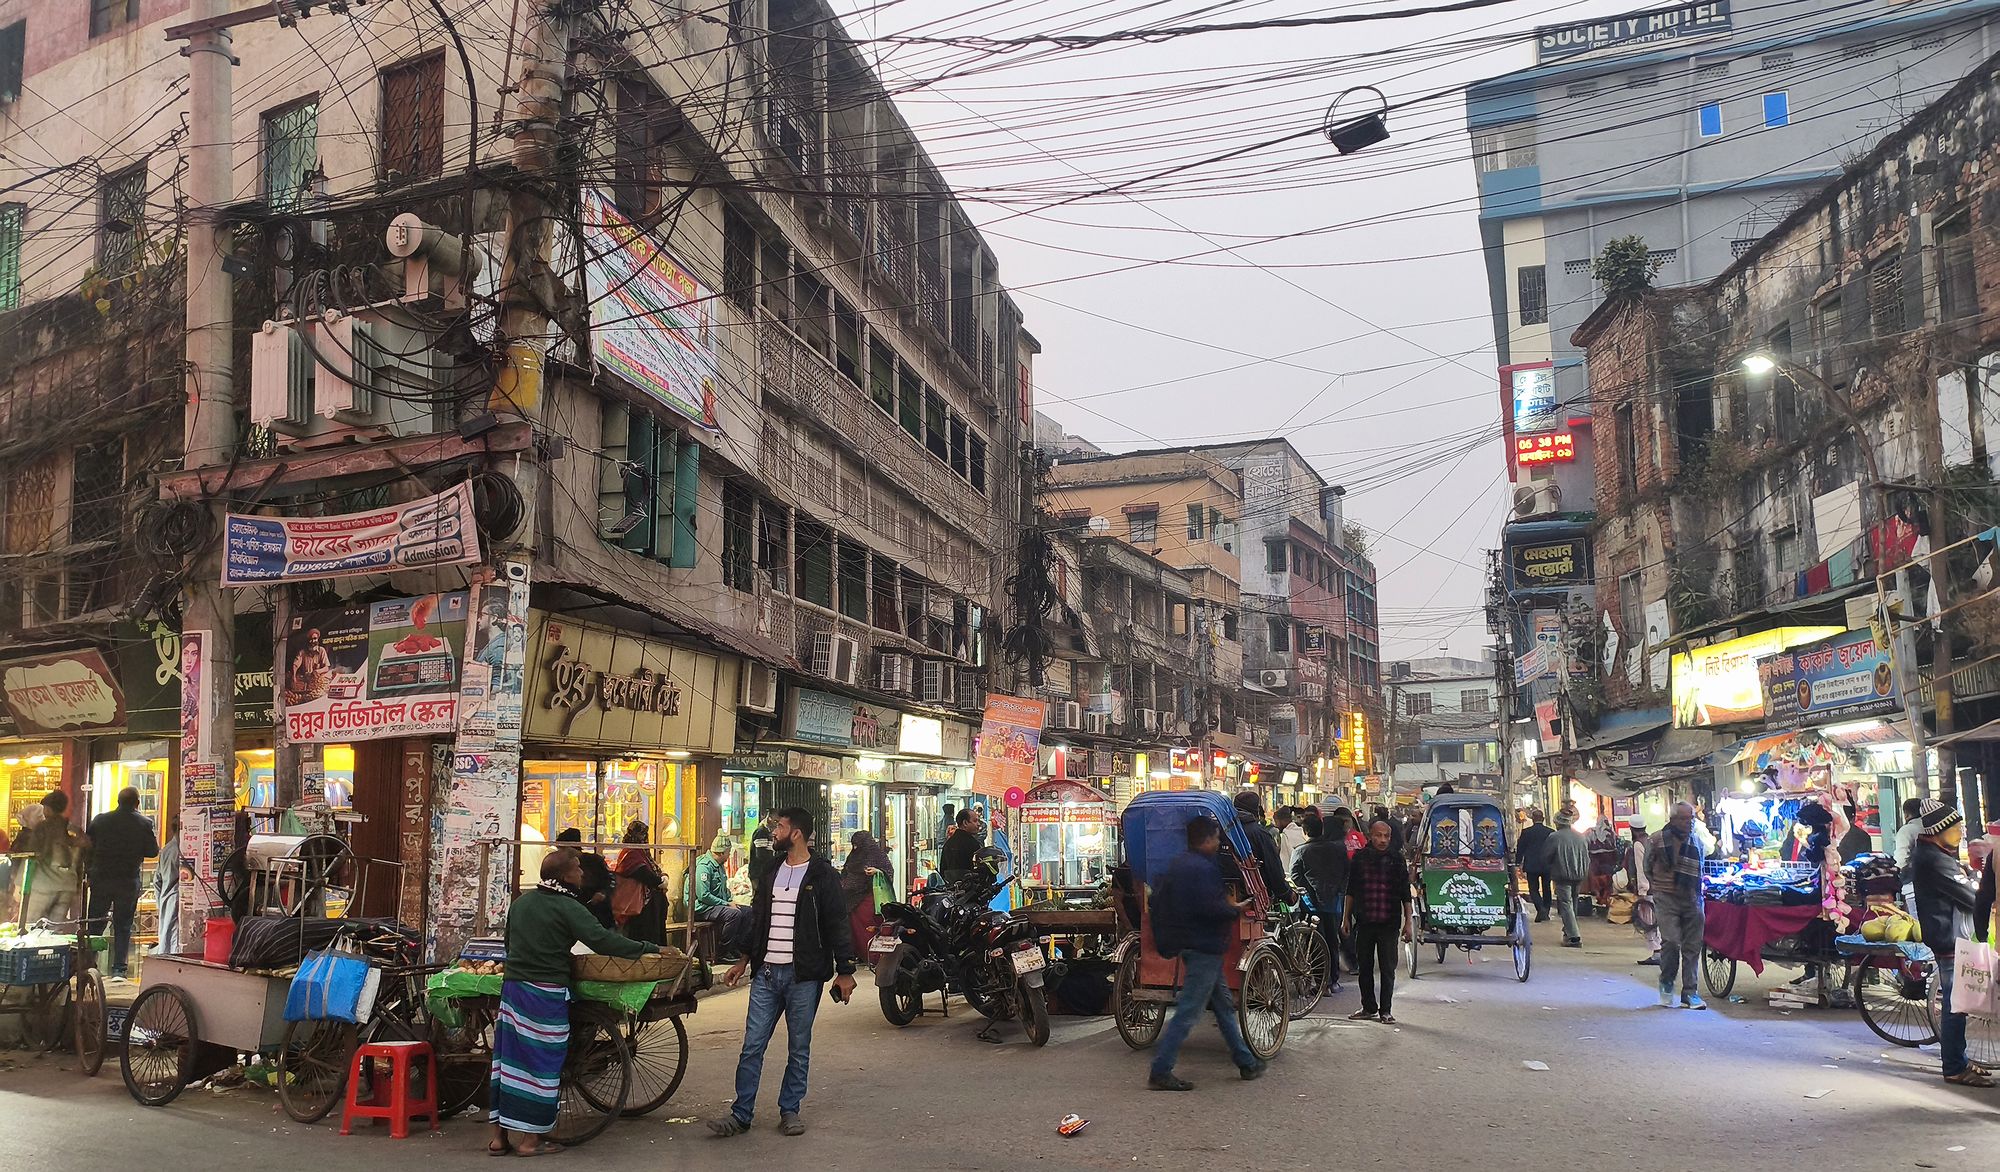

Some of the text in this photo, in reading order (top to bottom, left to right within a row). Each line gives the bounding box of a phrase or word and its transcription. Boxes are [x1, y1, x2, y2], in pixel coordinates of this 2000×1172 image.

[1543, 3, 1726, 48] SOCIETY HOTEL
[1555, 434, 1572, 446] PM
[290, 534, 354, 557] জাবের
[403, 543, 459, 564] Admission
[1524, 544, 1572, 561] মেহমান
[1798, 642, 1835, 675] কাকলি
[288, 699, 457, 740] নুপুর ডিজিটাল স্কেল
